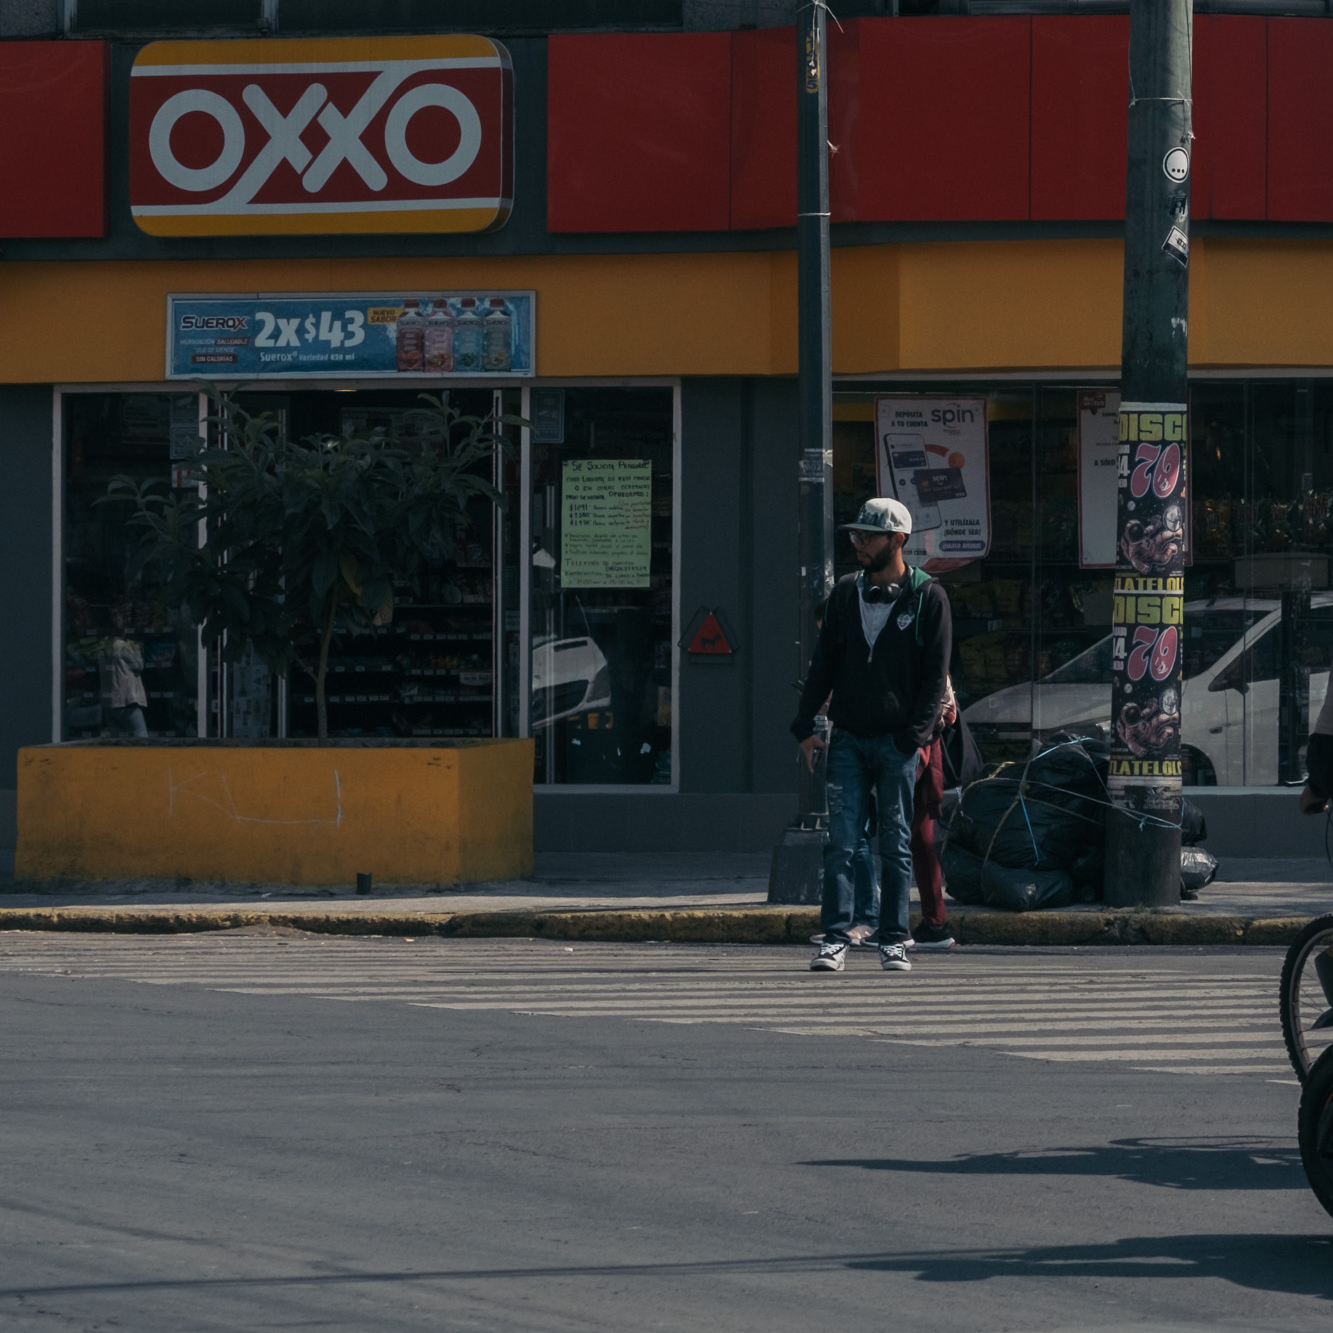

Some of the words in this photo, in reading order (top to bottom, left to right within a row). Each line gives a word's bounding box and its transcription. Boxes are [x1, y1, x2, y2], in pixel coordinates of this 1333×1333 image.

[149, 77, 482, 199] OXXO
[181, 315, 248, 331] SUEROX
[370, 315, 396, 323] SABOR
[299, 353, 329, 361] Variedad
[345, 352, 355, 361] ml
[931, 406, 974, 426] spin
[1119, 414, 1187, 441] DISC
